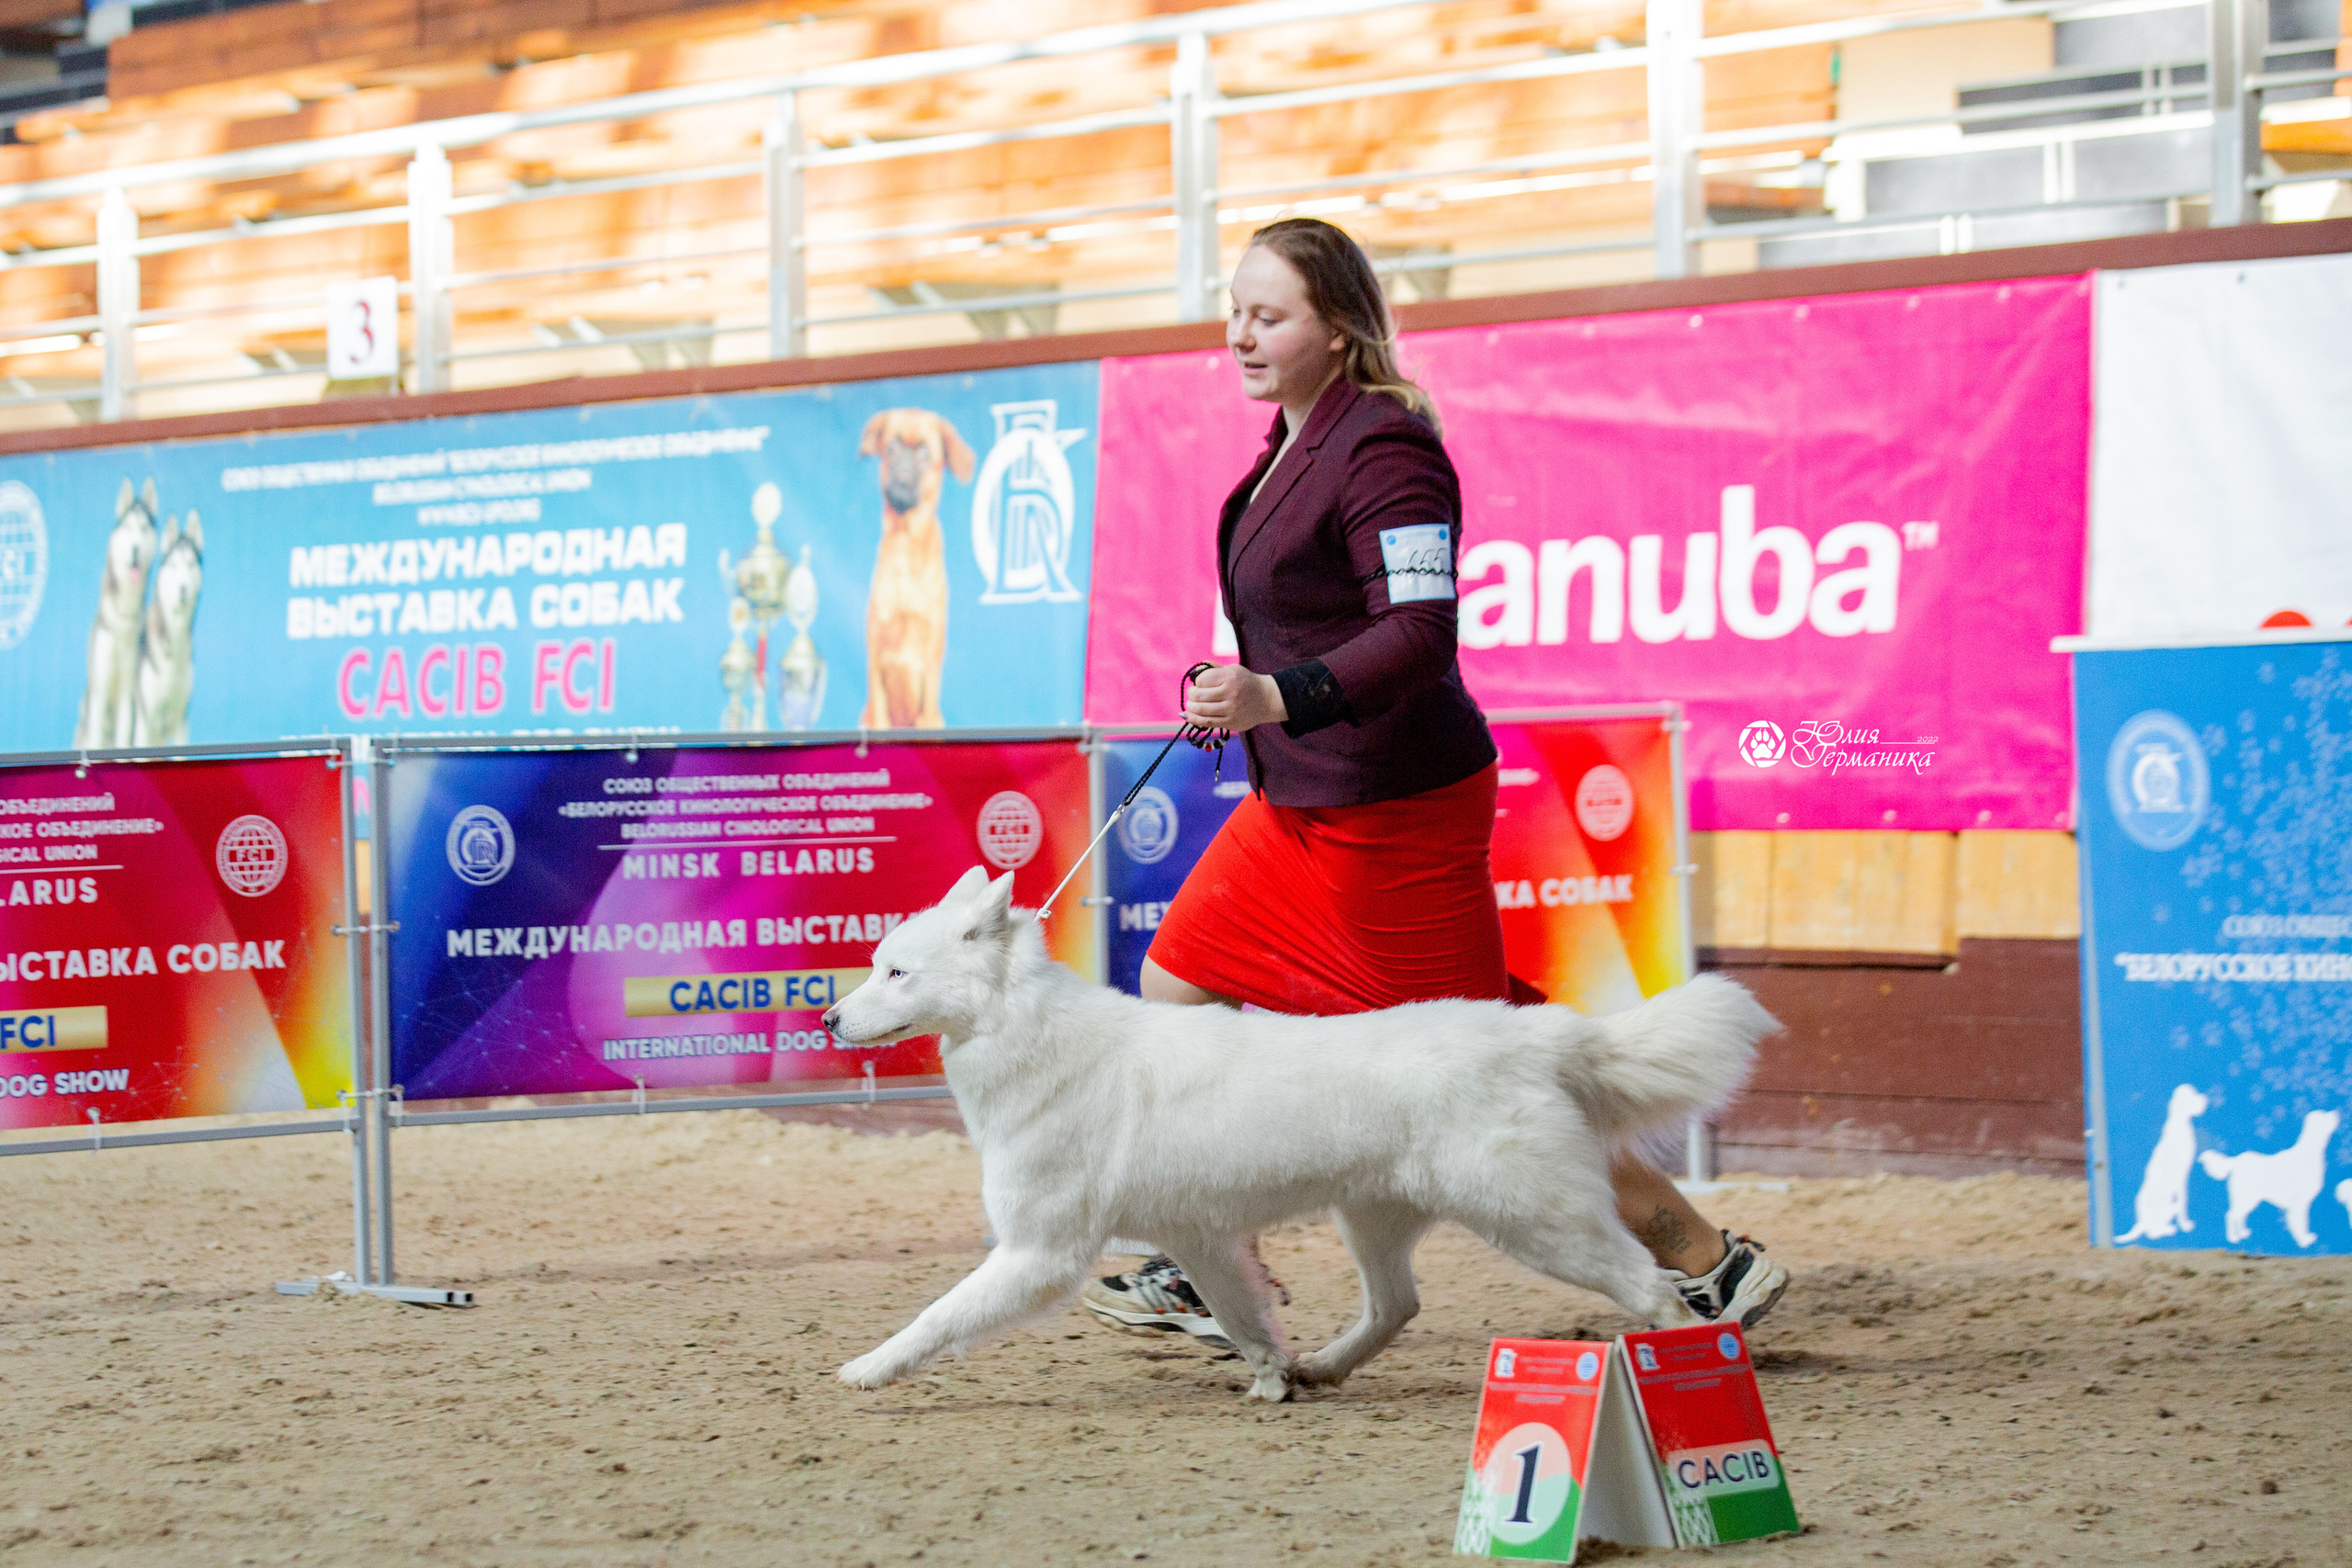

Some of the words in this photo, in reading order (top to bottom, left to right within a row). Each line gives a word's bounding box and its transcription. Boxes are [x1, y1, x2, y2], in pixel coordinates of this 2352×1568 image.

[349, 299, 373, 365] 3
[289, 523, 687, 589] МЕЖДУНАРОДНАЯ
[1213, 484, 1903, 655] anuba
[287, 586, 517, 639] ВЫСТАВКА
[530, 578, 684, 628] СОБАК
[338, 645, 505, 721] CACIB
[531, 638, 615, 714] FCI
[44, 843, 98, 862] UNION
[622, 852, 720, 879] MINSK
[741, 847, 875, 875] BELARUS
[1540, 874, 1634, 908] СОБАК
[447, 919, 748, 959] МЕЖДУНАРОДНАЯ
[757, 912, 921, 947] ВЫСТАВК
[167, 940, 286, 974] СОБАК
[670, 978, 772, 1012] CACIB
[785, 976, 834, 1007] FCI
[0, 1015, 56, 1049] FCI
[603, 1032, 770, 1060] INTERNATIONAL
[776, 1029, 827, 1052] DOG
[54, 1068, 130, 1095] SHOW
[1501, 1440, 1544, 1526] 1
[1677, 1449, 1770, 1489] CACIB
